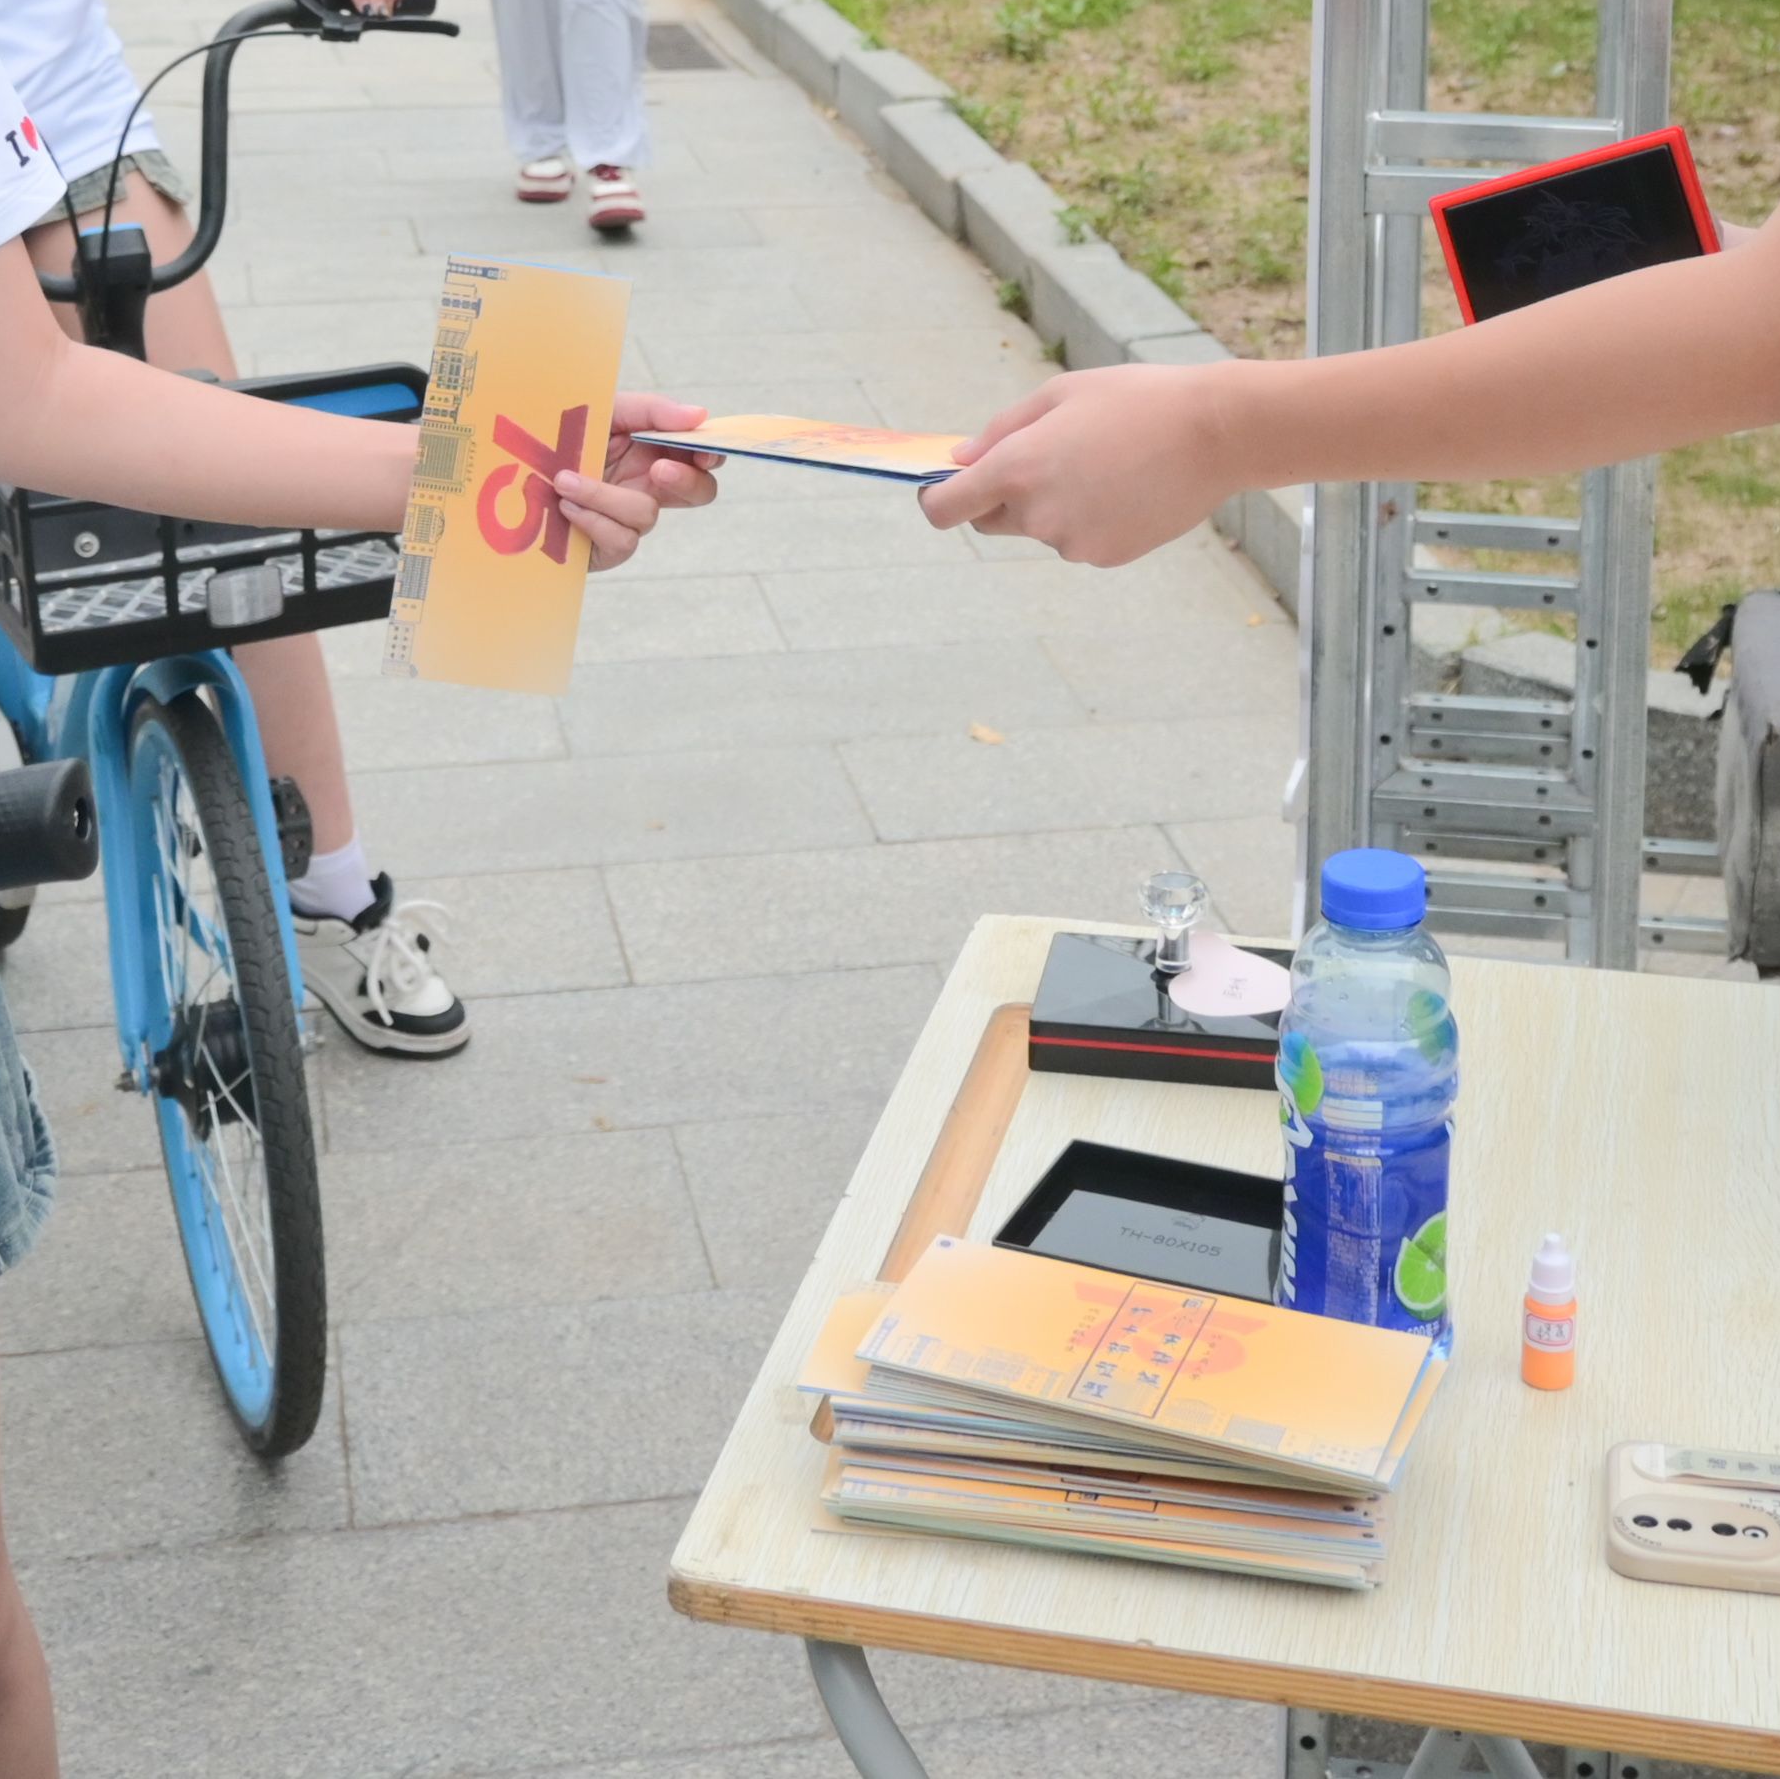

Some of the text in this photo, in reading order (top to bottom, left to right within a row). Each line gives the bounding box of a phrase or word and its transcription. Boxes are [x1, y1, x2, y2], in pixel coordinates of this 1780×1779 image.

[5, 130, 30, 169] I
[476, 403, 589, 566] 75
[1119, 1226, 1223, 1257] TH-80X105
